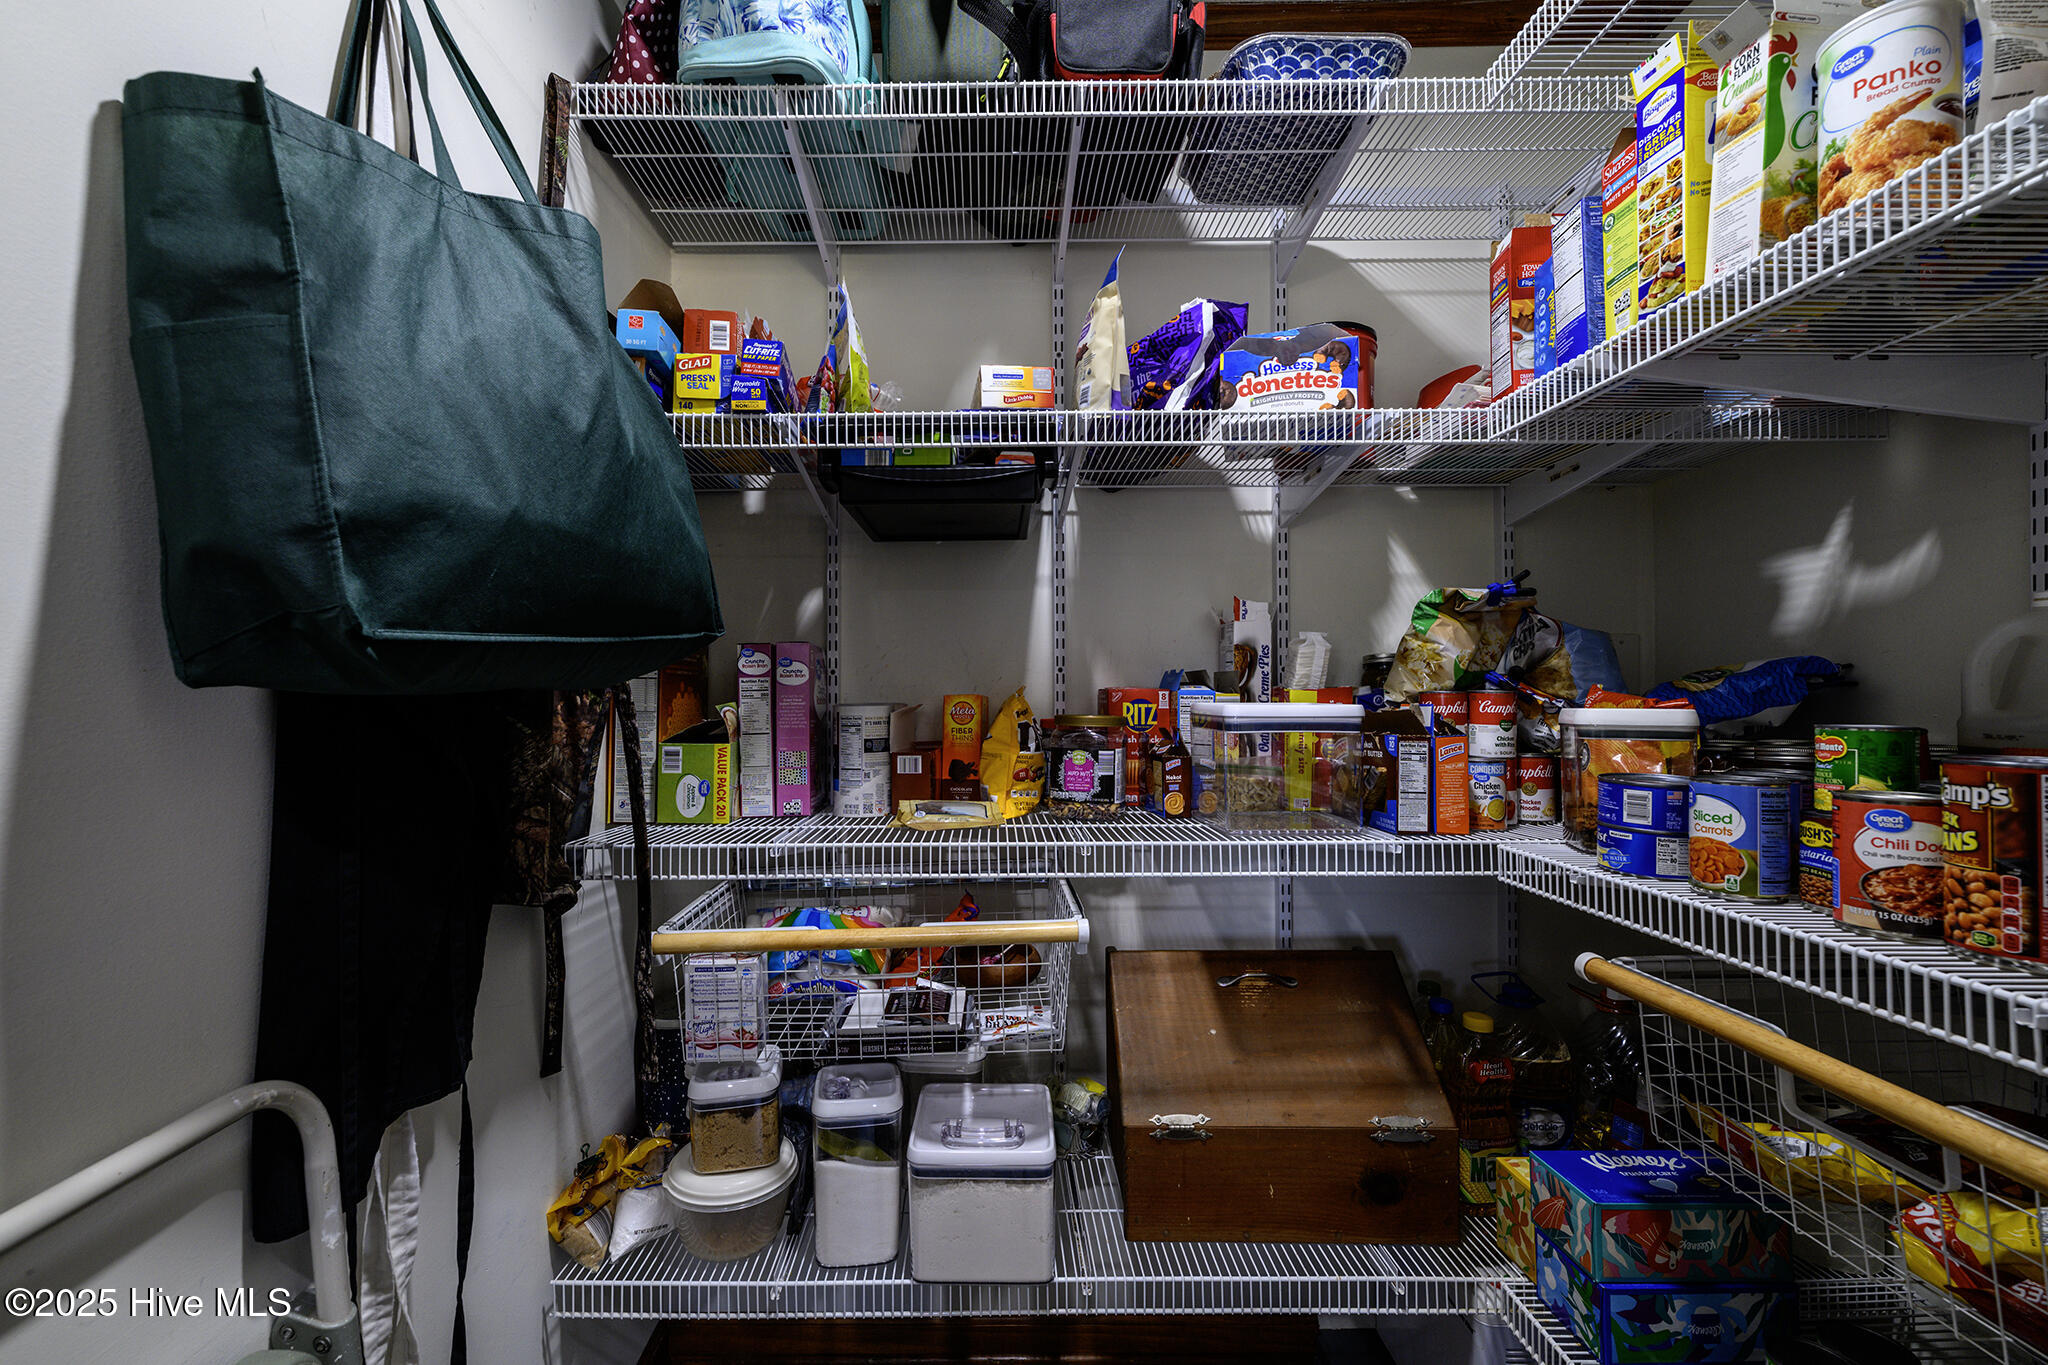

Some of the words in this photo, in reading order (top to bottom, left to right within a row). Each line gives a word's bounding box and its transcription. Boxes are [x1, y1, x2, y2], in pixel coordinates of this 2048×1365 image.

[1734, 43, 1761, 70] CORN
[1913, 44, 1941, 58] Plain
[1734, 53, 1761, 80] FLAKES
[1834, 49, 1866, 73] Great
[1853, 59, 1942, 99] Panko
[1866, 83, 1900, 103] Bread
[1901, 76, 1942, 91] Crumbs
[1643, 90, 1677, 121] Bisquick
[1638, 111, 1682, 145] DISCOVER
[1644, 119, 1682, 152] GREAT
[1643, 128, 1682, 161] RECIPES
[1622, 180, 1635, 194] RICE
[743, 346, 780, 357] CUT-RITE
[679, 357, 710, 370] GLAD
[680, 374, 716, 382] PRESS'N
[734, 380, 760, 388] Reynolds
[1238, 372, 1340, 397] donettes
[678, 401, 693, 409] 140
[1258, 645, 1270, 670] Pies
[1258, 670, 1270, 703] Creme
[1161, 692, 1167, 700] 8
[1122, 702, 1158, 727] RITZ
[1440, 745, 1463, 757] Lance
[1820, 743, 1843, 751] Monte
[717, 746, 728, 775] VALUE
[717, 777, 727, 803] PACK
[1474, 782, 1501, 790] Chicken
[1943, 783, 2010, 811] amp's
[716, 805, 727, 817] 20
[1693, 809, 1733, 824] Sliced
[1870, 814, 1904, 824] Great
[1878, 821, 1904, 829] Value
[1694, 822, 1733, 837] Carrots
[1870, 837, 1909, 851] Chili
[1950, 854, 1980, 866] SAUCE
[1878, 912, 1889, 920] 15
[1891, 913, 1902, 921] OZ
[1480, 1068, 1507, 1076] Healthy
[1522, 1122, 1558, 1131] getable
[1581, 1152, 1687, 1173] Kleenex
[1680, 1239, 1717, 1253] Kleenex
[1688, 1323, 1725, 1337] Kleenex
